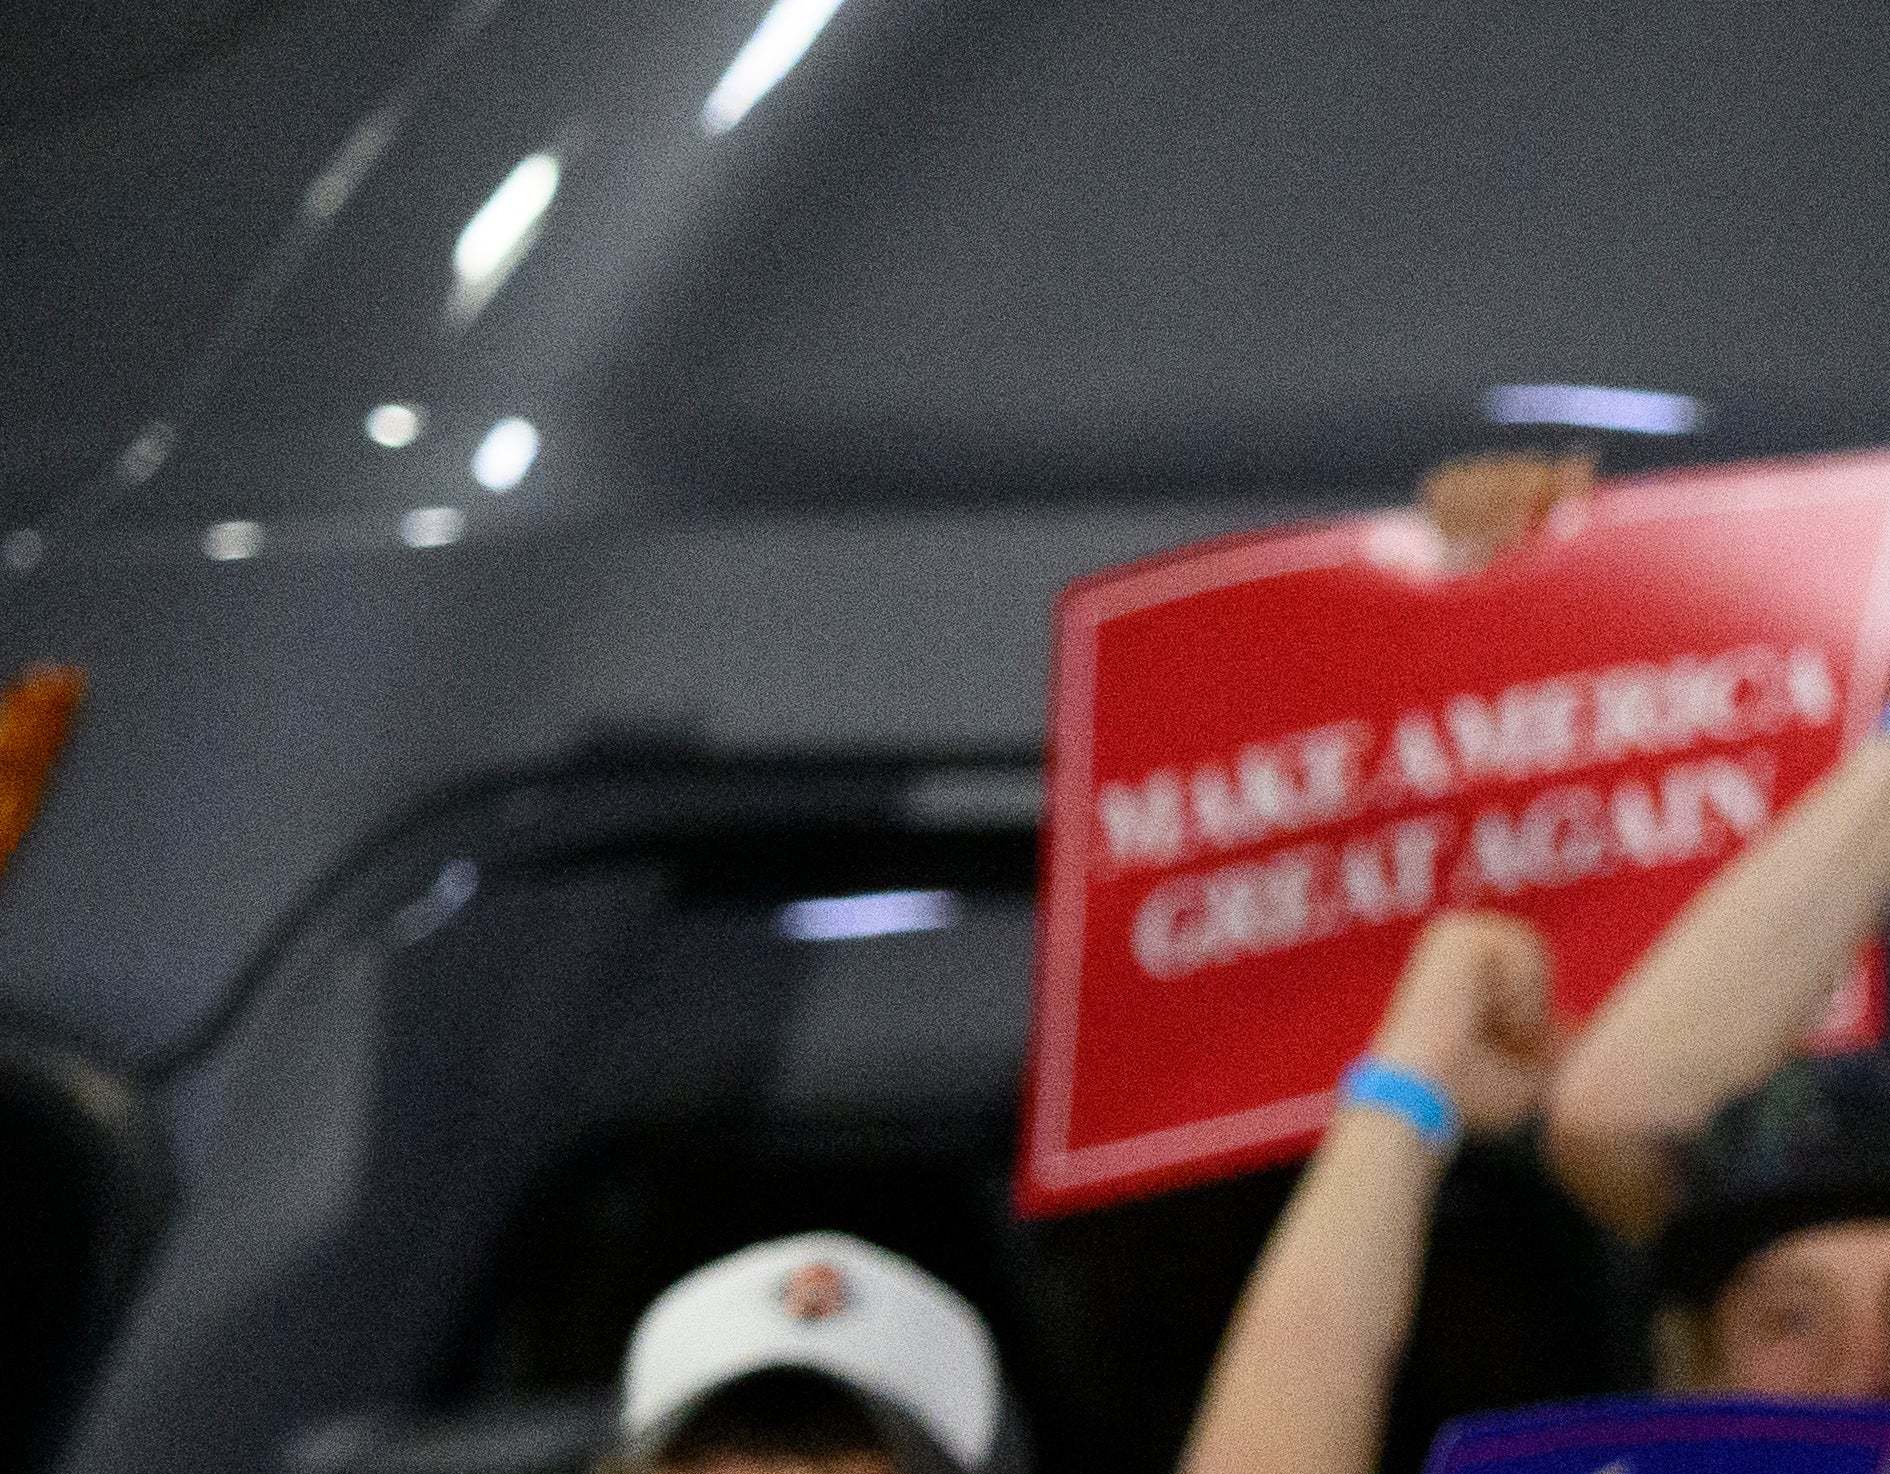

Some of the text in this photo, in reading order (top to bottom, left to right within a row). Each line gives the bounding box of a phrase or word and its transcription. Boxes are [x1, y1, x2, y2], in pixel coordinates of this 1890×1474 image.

[1098, 640, 1840, 862] MAKE AMERICA
[1128, 752, 1778, 982] GREAT AGAIN
